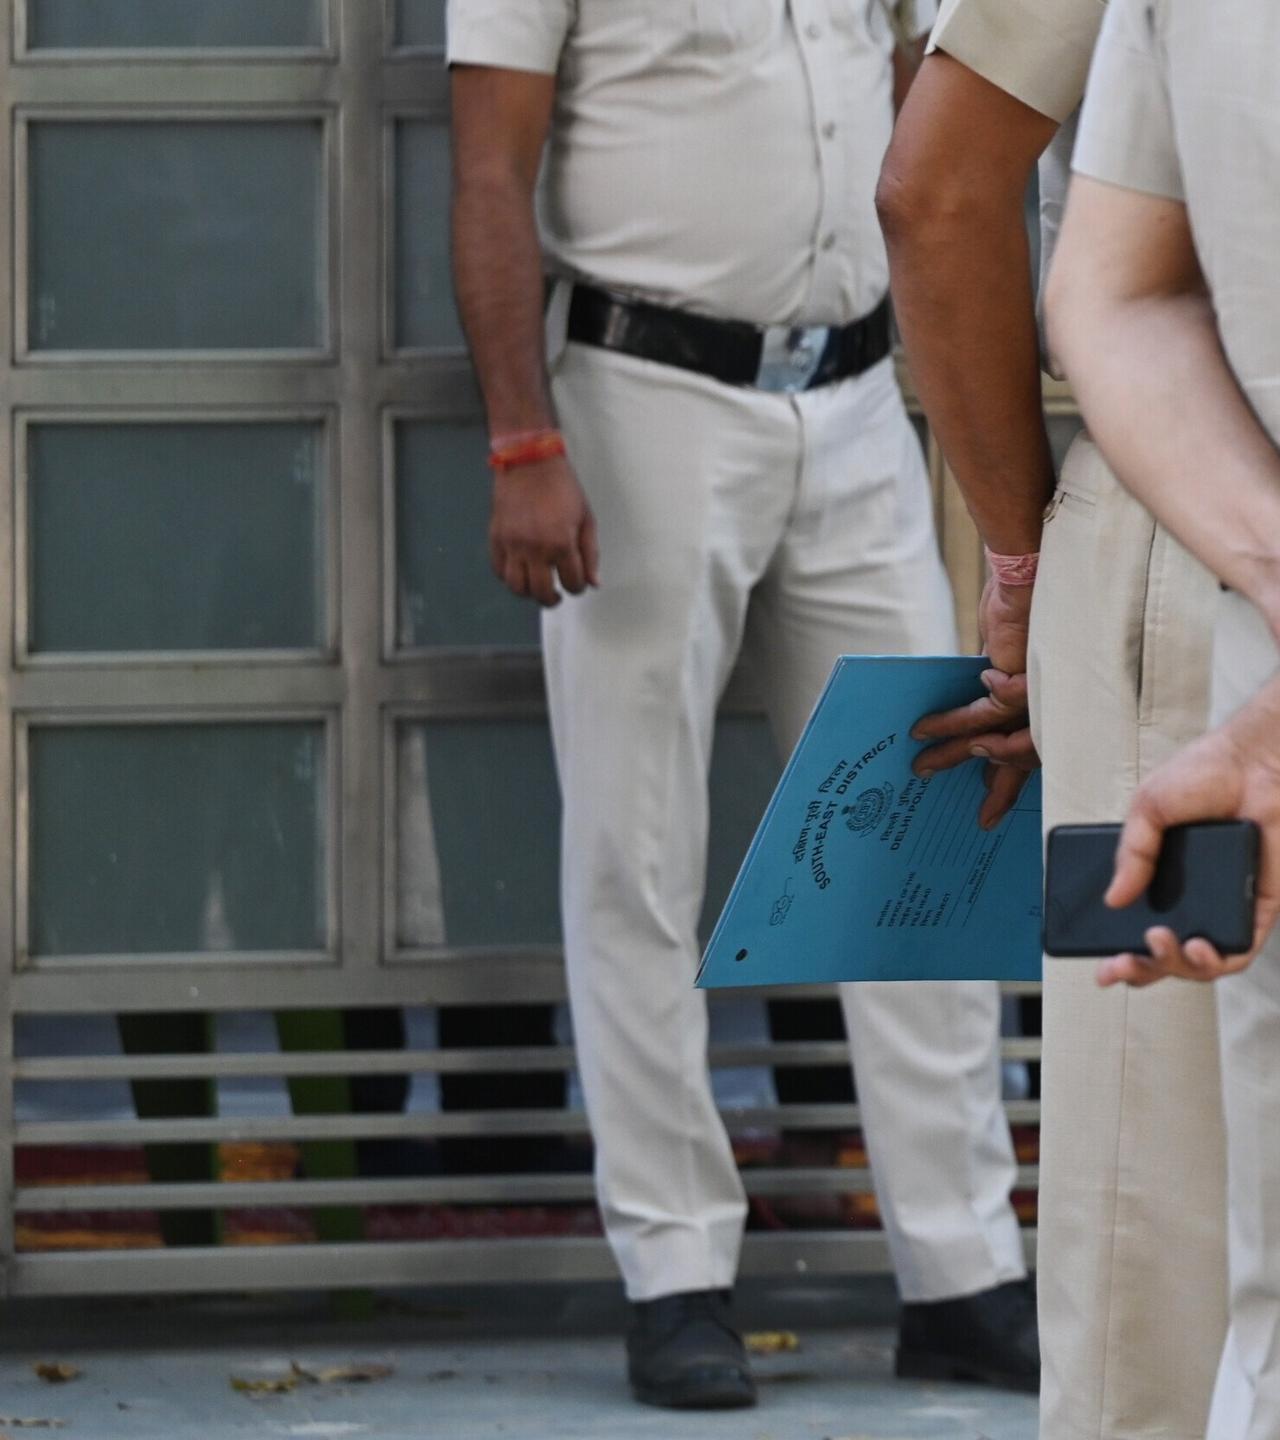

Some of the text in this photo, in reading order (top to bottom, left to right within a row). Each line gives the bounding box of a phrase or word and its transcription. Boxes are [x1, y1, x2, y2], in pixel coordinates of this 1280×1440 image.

[811, 733, 897, 890] SOUTH-EAST DISTRICT
[889, 777, 932, 851] DELHI POLIC
